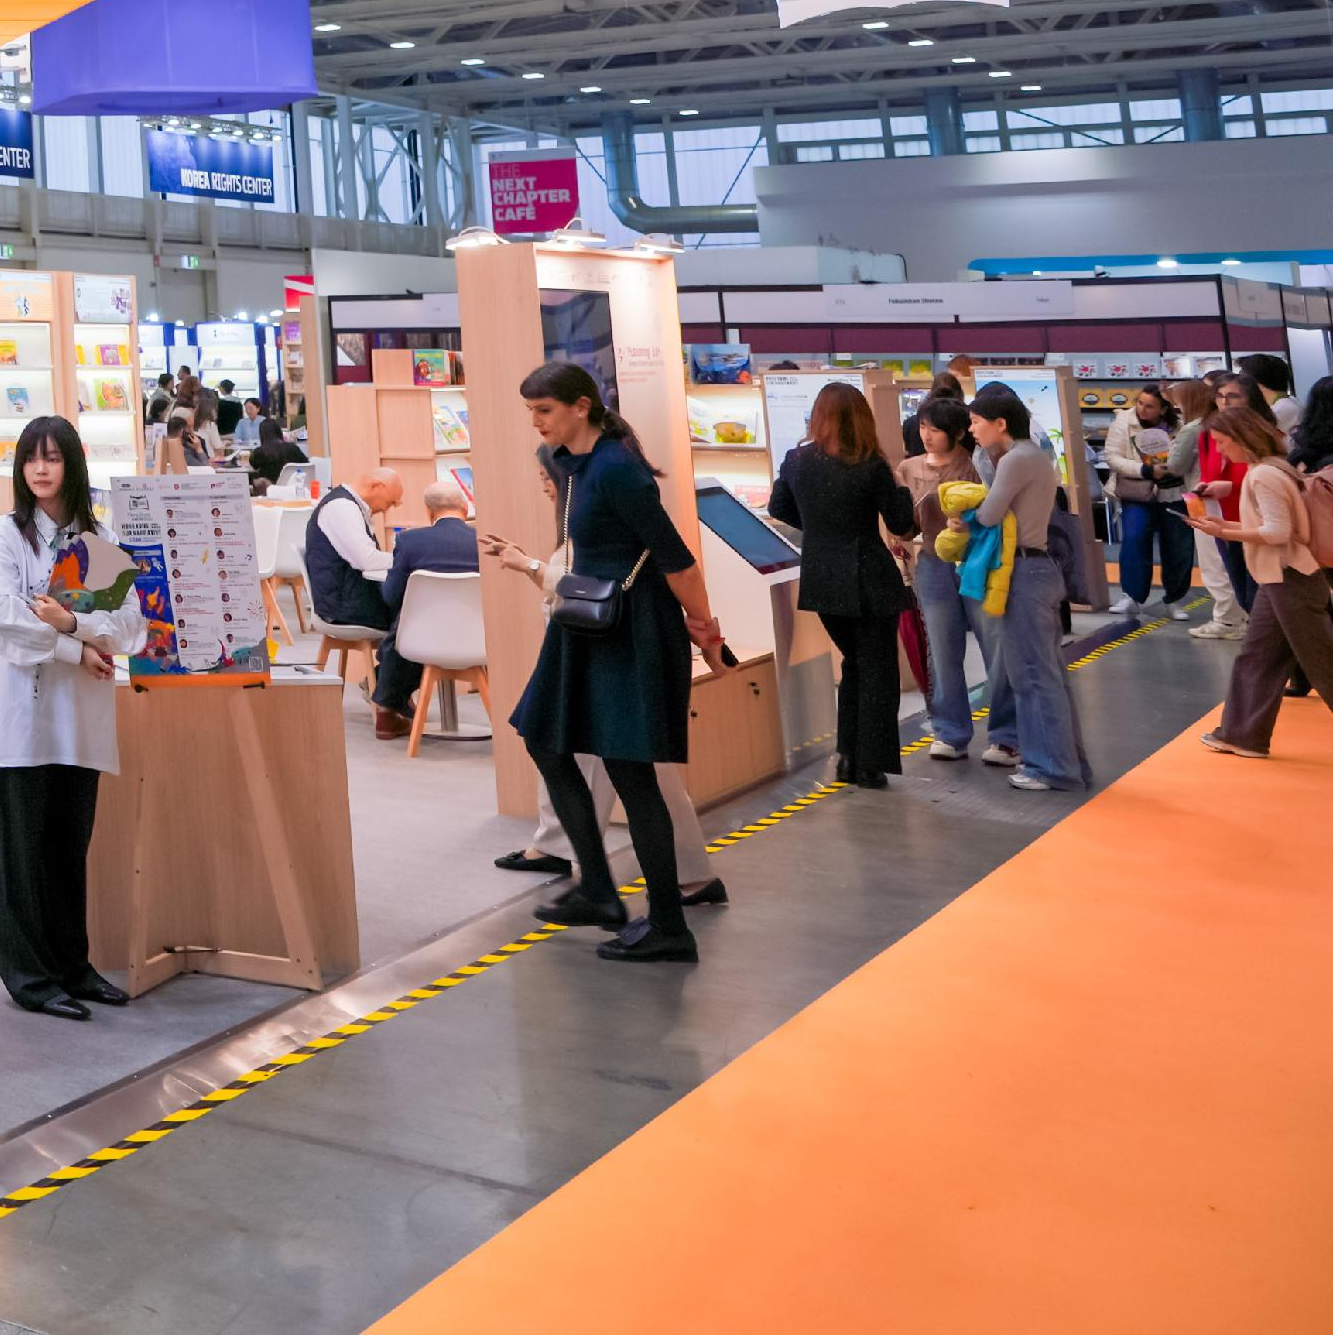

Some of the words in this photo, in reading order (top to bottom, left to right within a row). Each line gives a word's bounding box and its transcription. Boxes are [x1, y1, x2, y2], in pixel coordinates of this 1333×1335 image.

[180, 168, 210, 190] KOREA
[211, 171, 241, 192] RIGHTS
[242, 175, 273, 196] CENTER
[493, 176, 537, 192] NEXT
[492, 188, 571, 206] CHAPTER
[493, 203, 537, 222] CAFÉ
